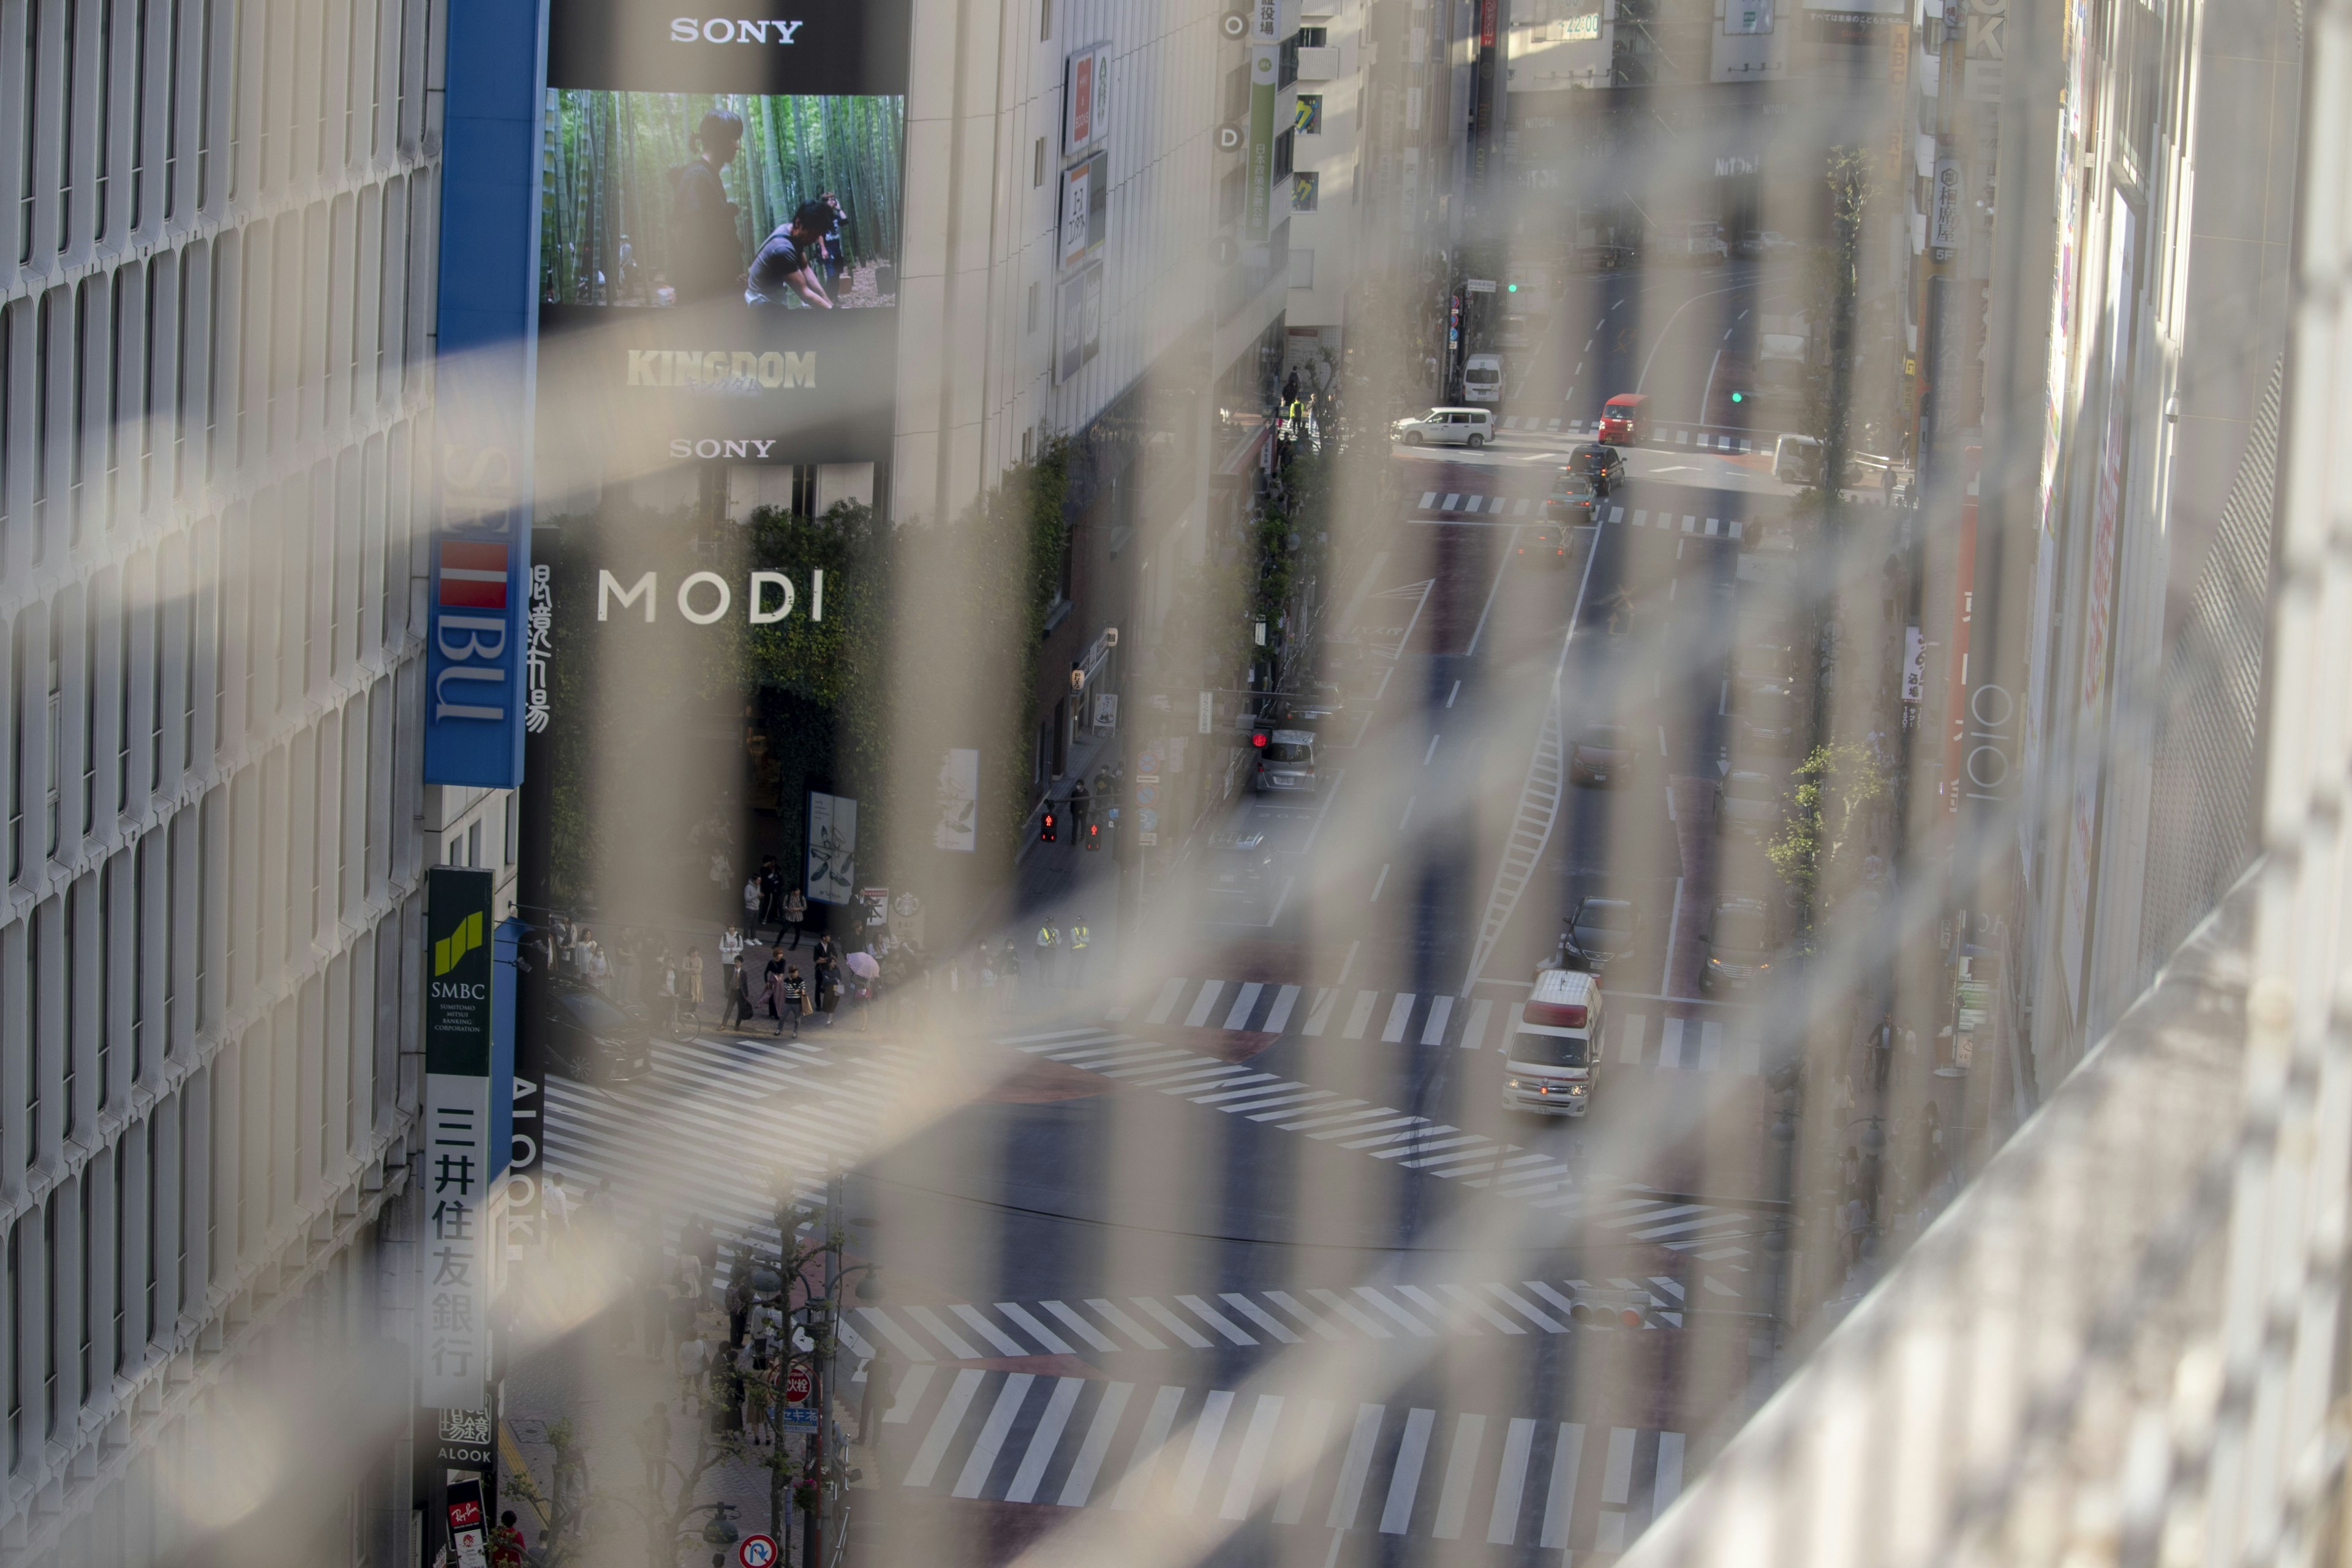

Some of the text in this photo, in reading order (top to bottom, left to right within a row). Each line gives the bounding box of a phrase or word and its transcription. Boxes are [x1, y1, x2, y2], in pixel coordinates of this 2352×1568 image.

[671, 17, 803, 44] SONY
[1075, 111, 1089, 129] BOOKS
[1936, 249, 1953, 260] 5F
[627, 349, 817, 389] KINGDOM
[669, 439, 776, 459] SONY
[597, 569, 824, 625] MODI
[431, 982, 485, 1000] SMBC
[431, 1107, 475, 1378] 三井住友銀行
[438, 1448, 491, 1463] ALOOK
[451, 1503, 478, 1521] Ray-Ban
